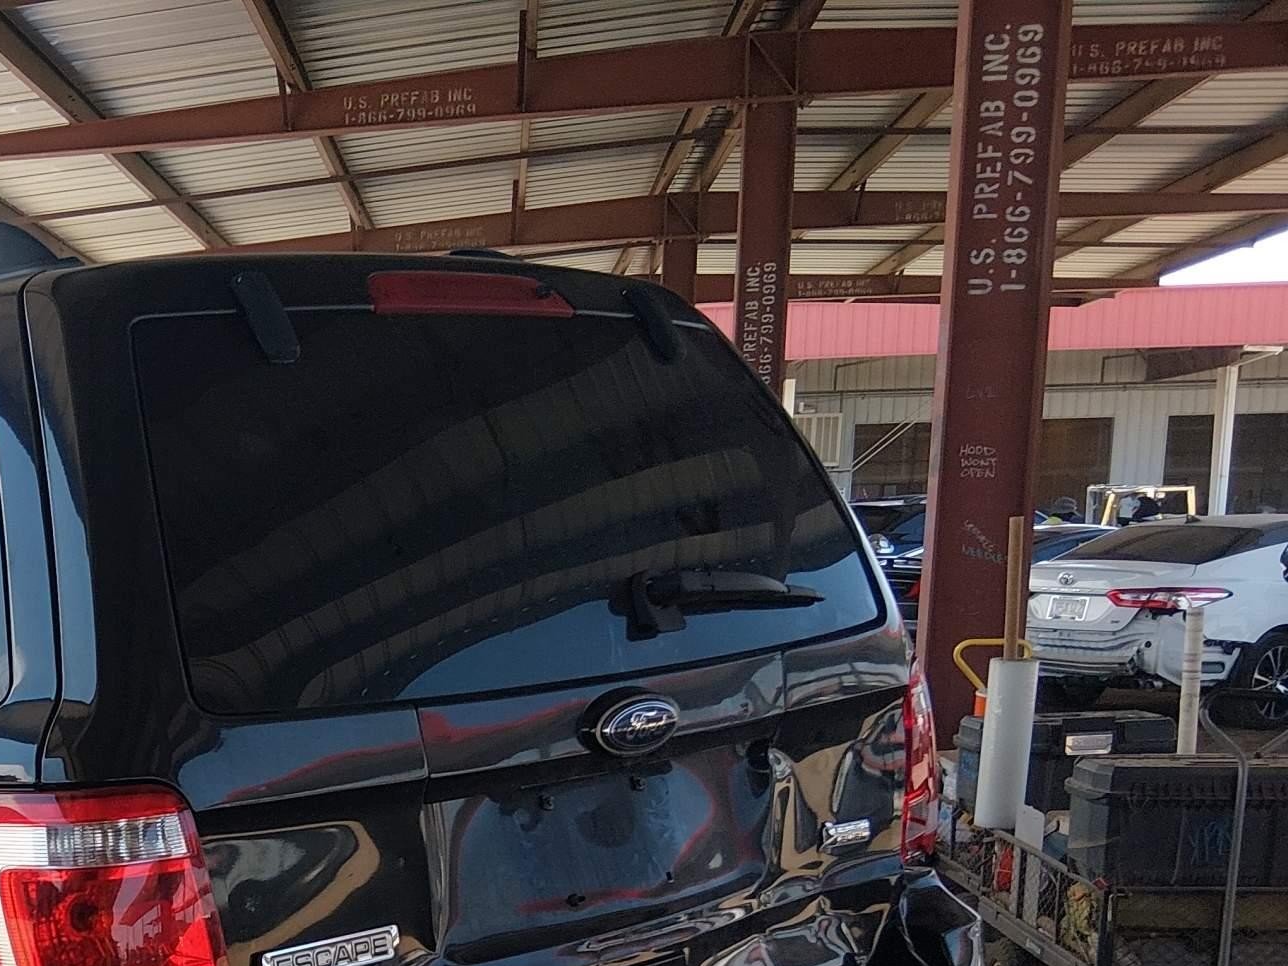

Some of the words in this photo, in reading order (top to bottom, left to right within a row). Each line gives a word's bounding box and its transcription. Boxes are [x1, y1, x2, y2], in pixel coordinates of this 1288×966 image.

[981, 23, 1011, 82] INC.
[1115, 38, 1185, 57] PREFAB
[380, 89, 440, 108] PREFAB
[973, 100, 1006, 219] PREFAB
[1000, 22, 1044, 292] 1-866-799-0969
[745, 261, 761, 293] INC.
[967, 239, 997, 297] U.S.
[743, 300, 759, 362] PREFAB
